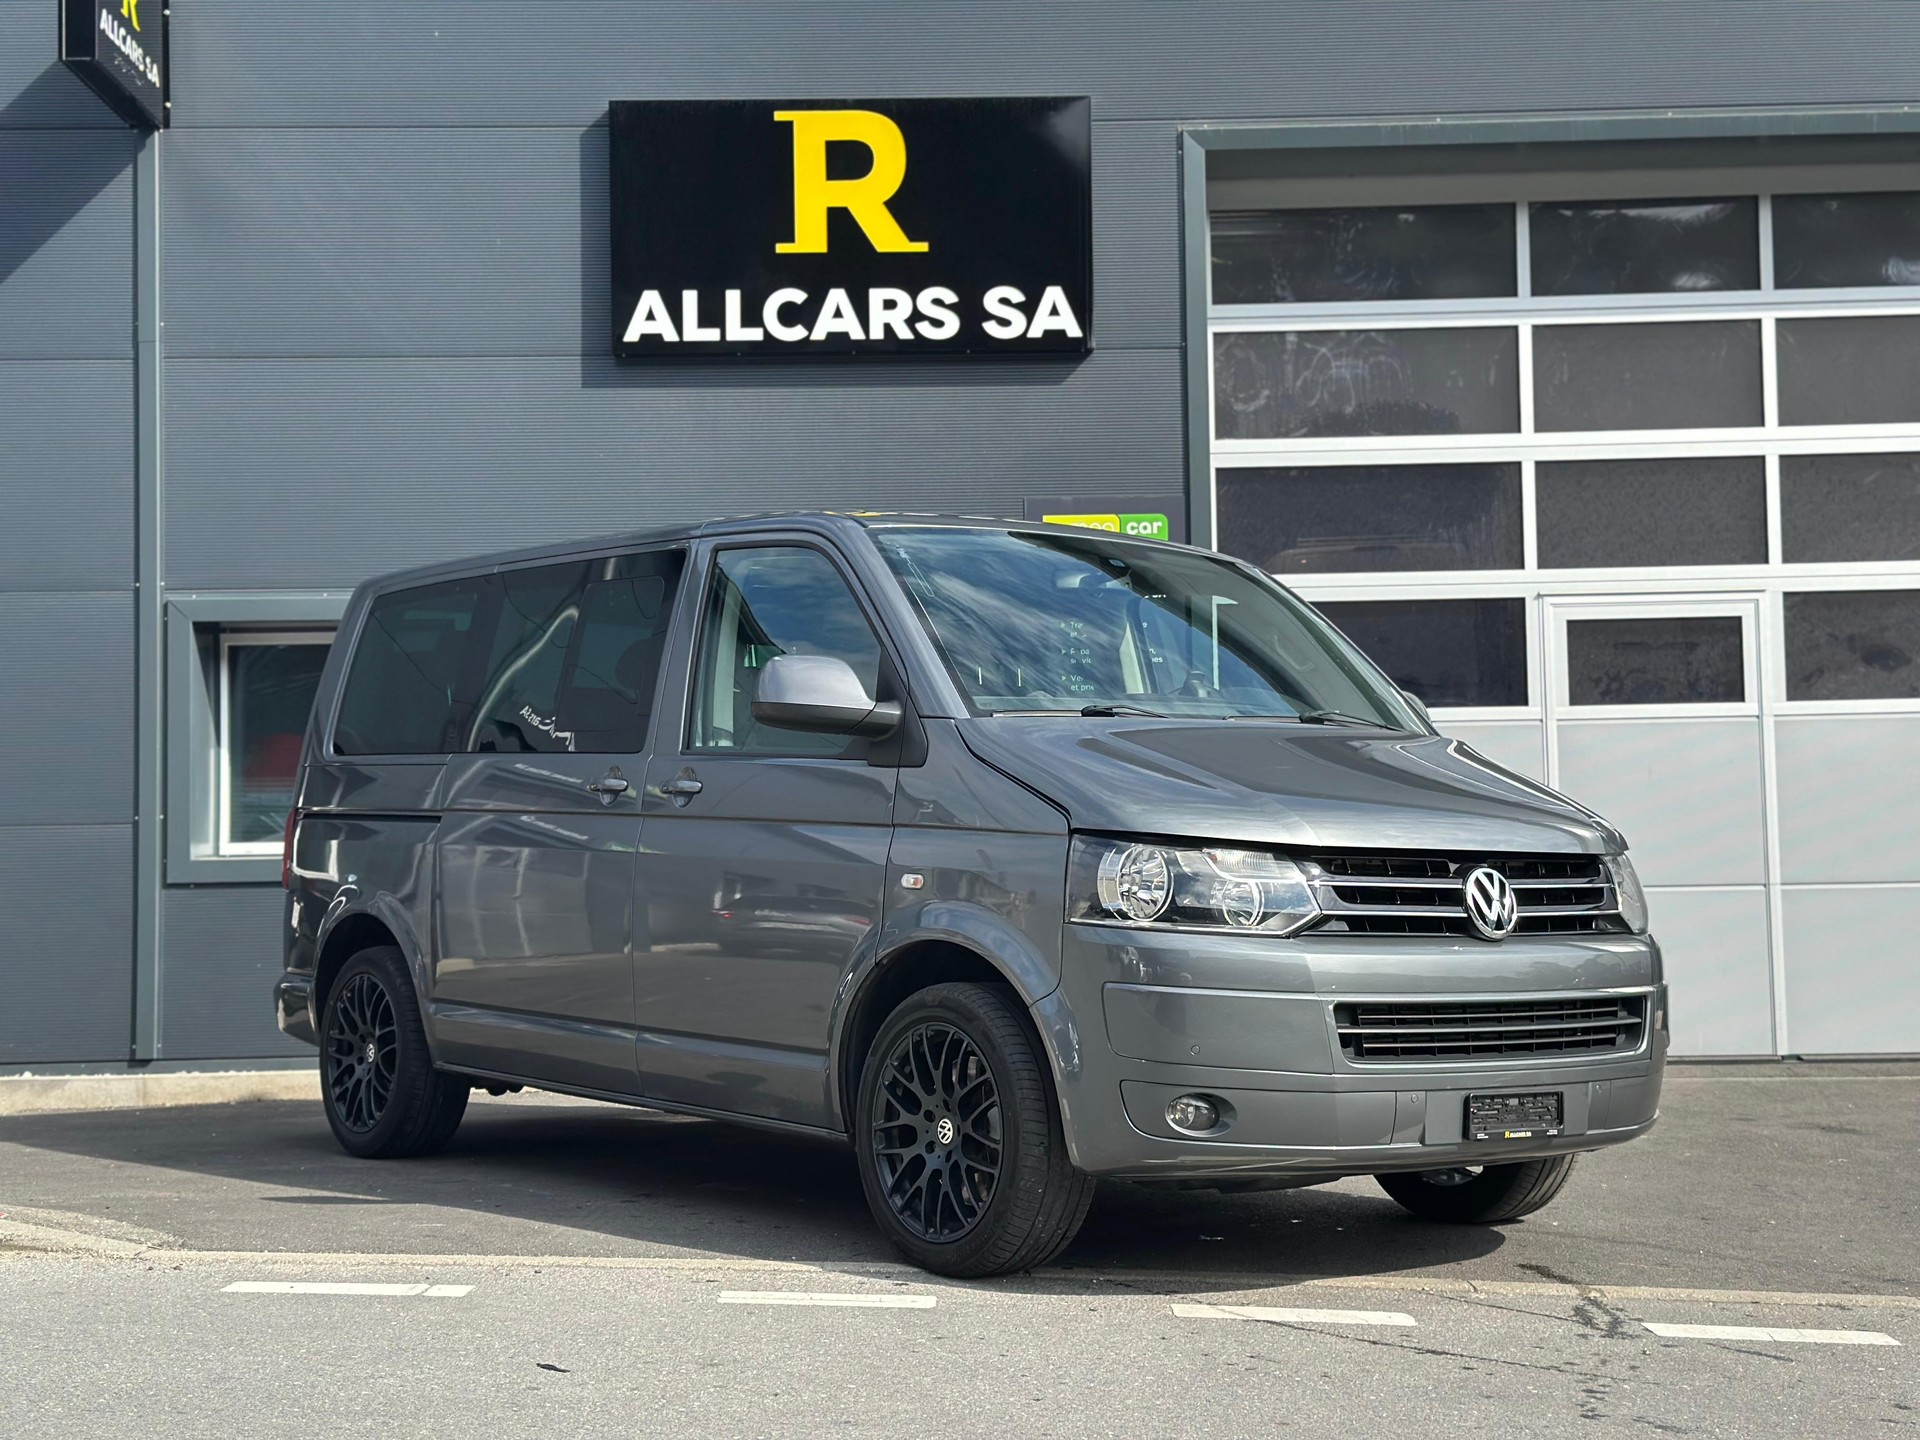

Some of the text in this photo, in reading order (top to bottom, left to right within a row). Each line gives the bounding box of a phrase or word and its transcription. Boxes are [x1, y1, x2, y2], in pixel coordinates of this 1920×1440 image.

[100, 8, 145, 72] ALLCARS
[145, 55, 160, 88] SA
[773, 109, 929, 254] R
[622, 285, 1084, 342] ALLCARS SA
[1126, 520, 1163, 535] car
